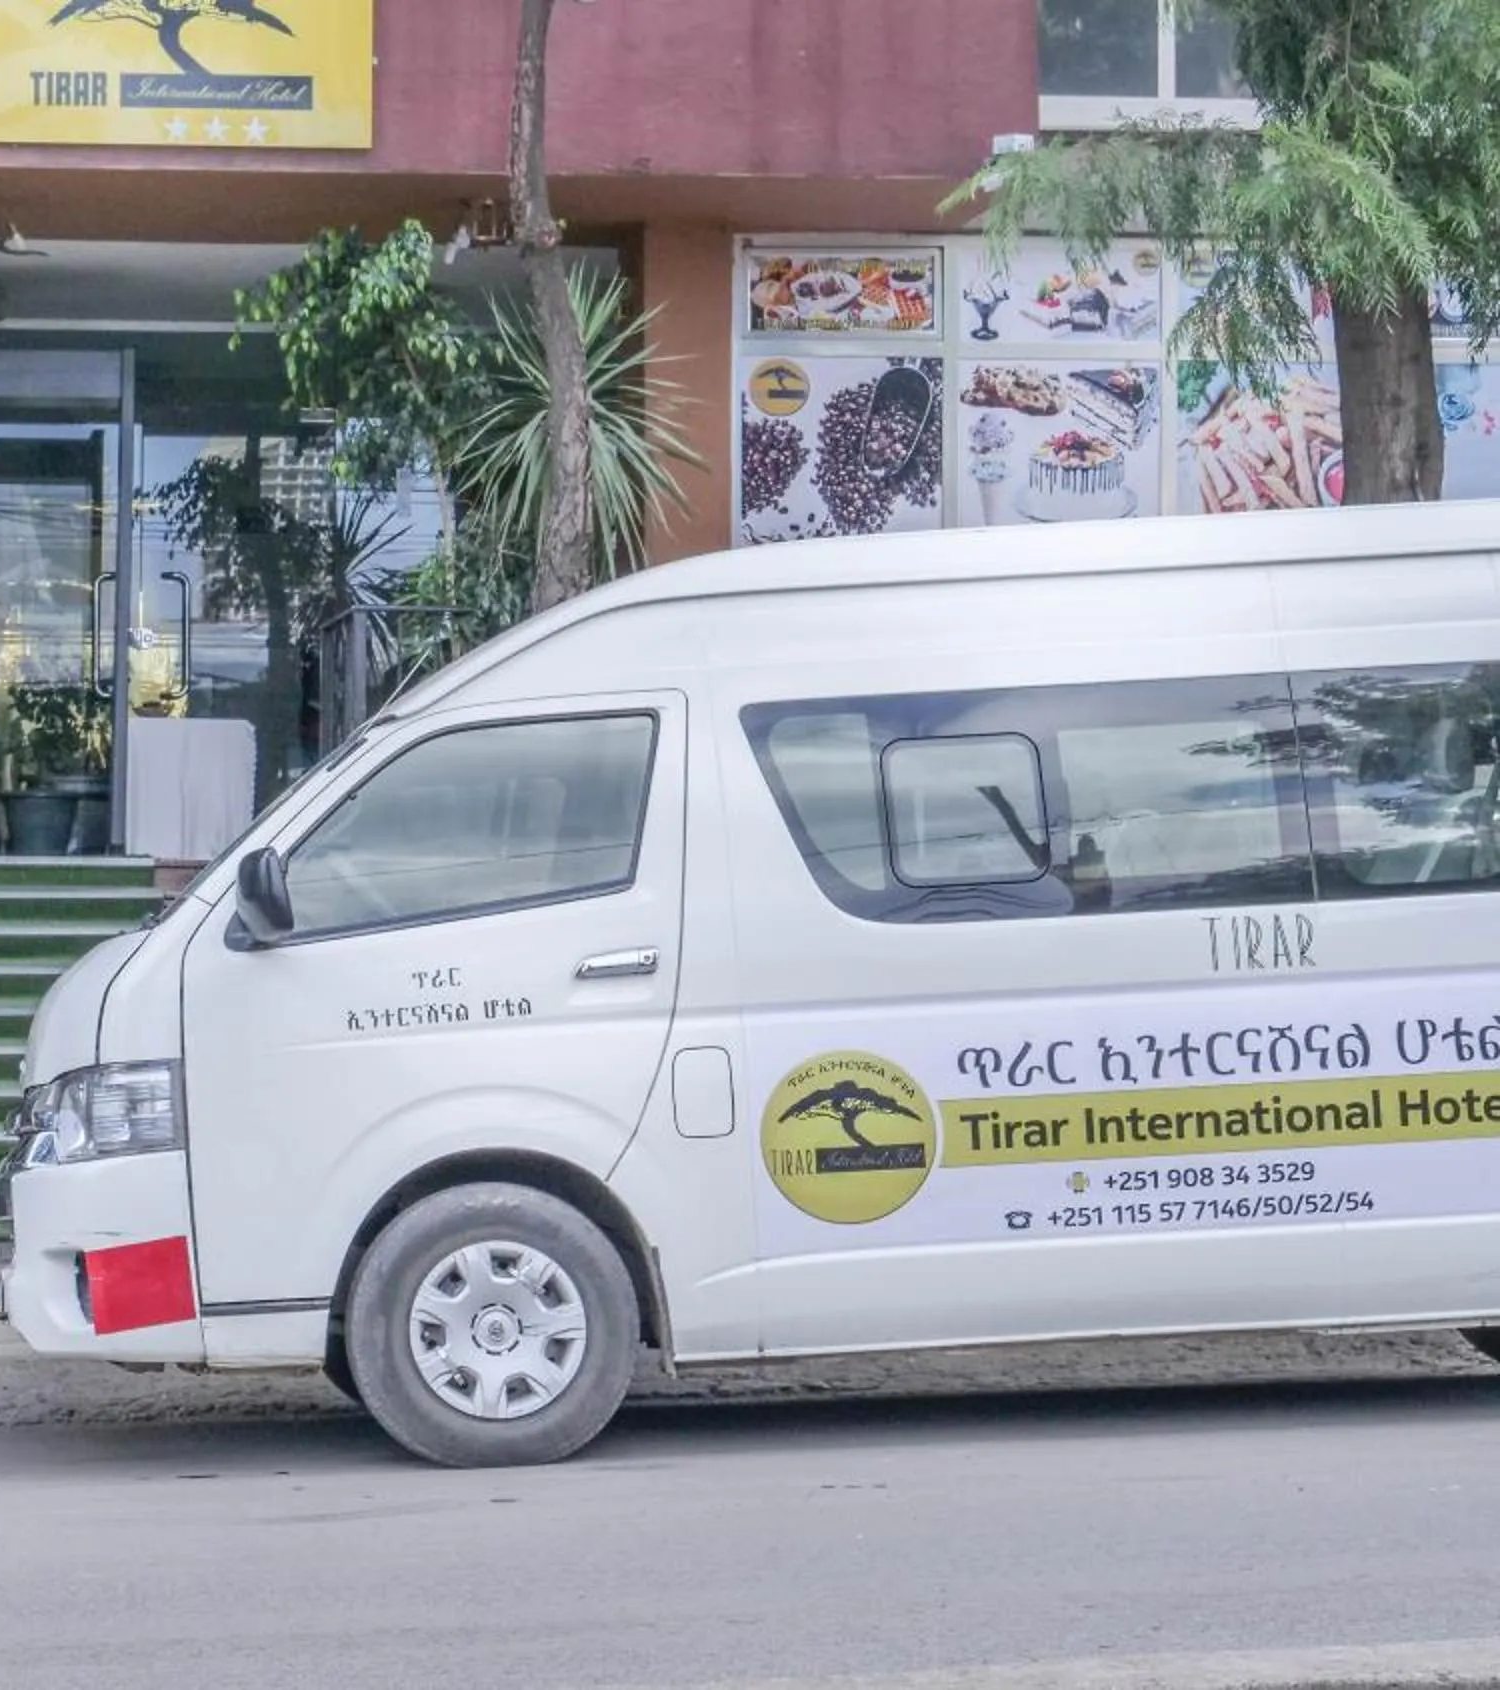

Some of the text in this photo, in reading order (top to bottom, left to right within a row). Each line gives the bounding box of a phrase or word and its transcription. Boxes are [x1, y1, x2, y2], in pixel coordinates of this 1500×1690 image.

[30, 71, 107, 106] TIRAR
[1200, 914, 1316, 971] TIRAR
[957, 1041, 1077, 1088] ጥራር
[1098, 1023, 1371, 1085] ኢንተርናሽናል
[959, 1111, 1069, 1151] Tirar
[1084, 1089, 1383, 1145] International
[771, 1149, 813, 1176] TIRAR
[1103, 1162, 1316, 1192] +251 908 34 3529
[1047, 1190, 1375, 1228] +251 115 57 7146/50/52/54
